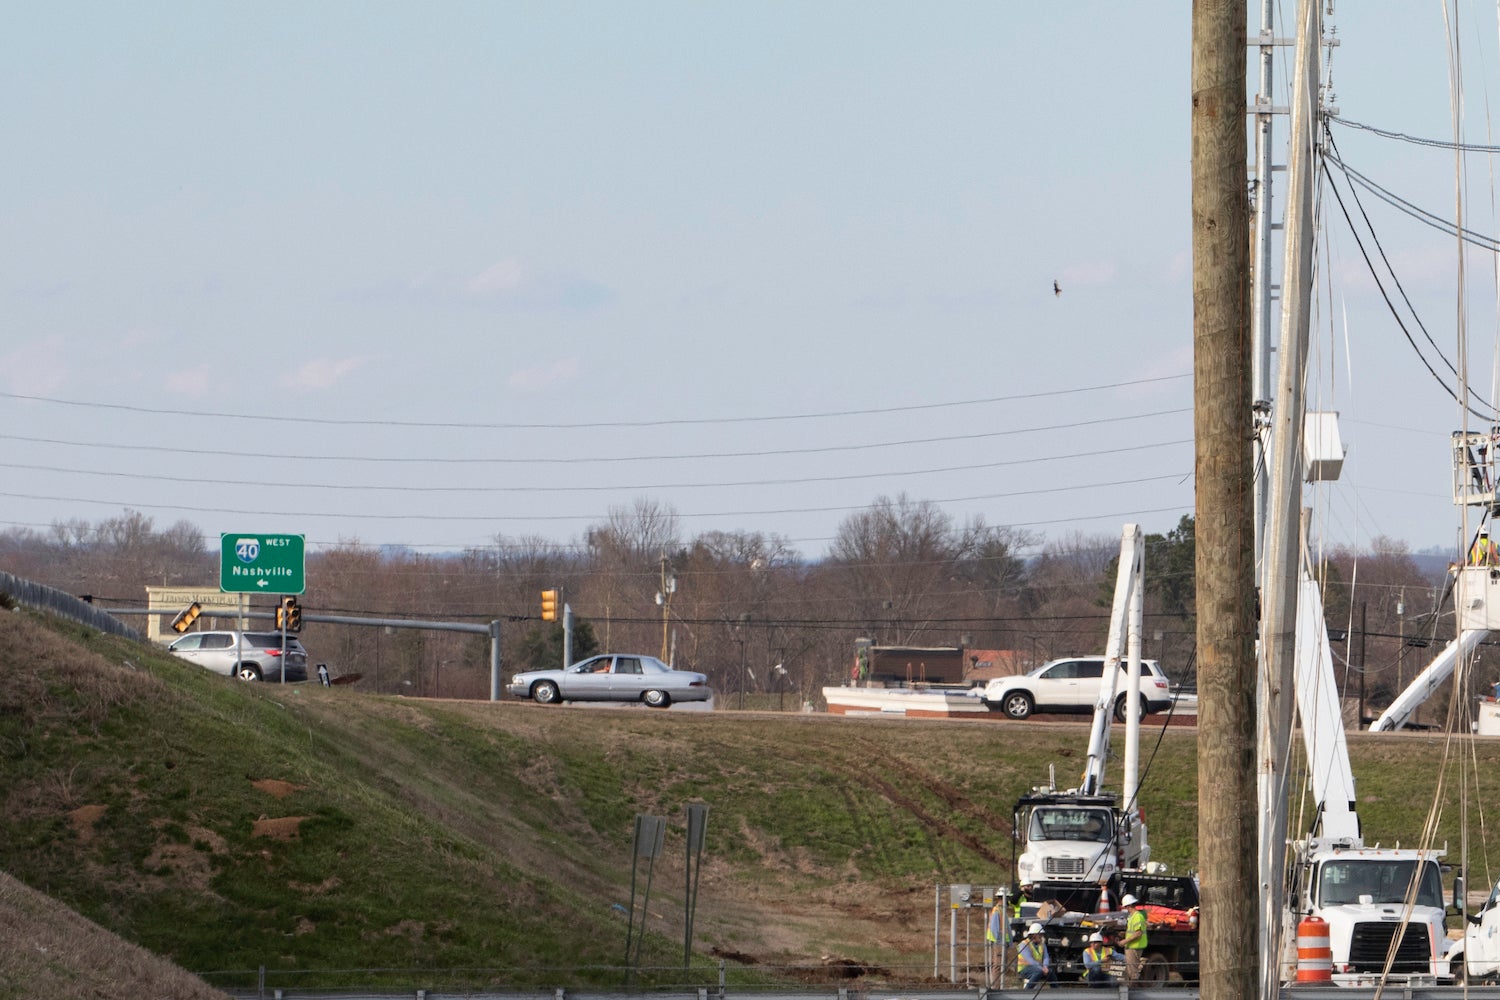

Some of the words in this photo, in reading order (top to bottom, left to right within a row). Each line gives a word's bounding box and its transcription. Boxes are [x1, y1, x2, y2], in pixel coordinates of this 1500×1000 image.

[265, 538, 291, 547] WEST
[237, 545, 259, 559] 40
[232, 565, 293, 577] Nashville
